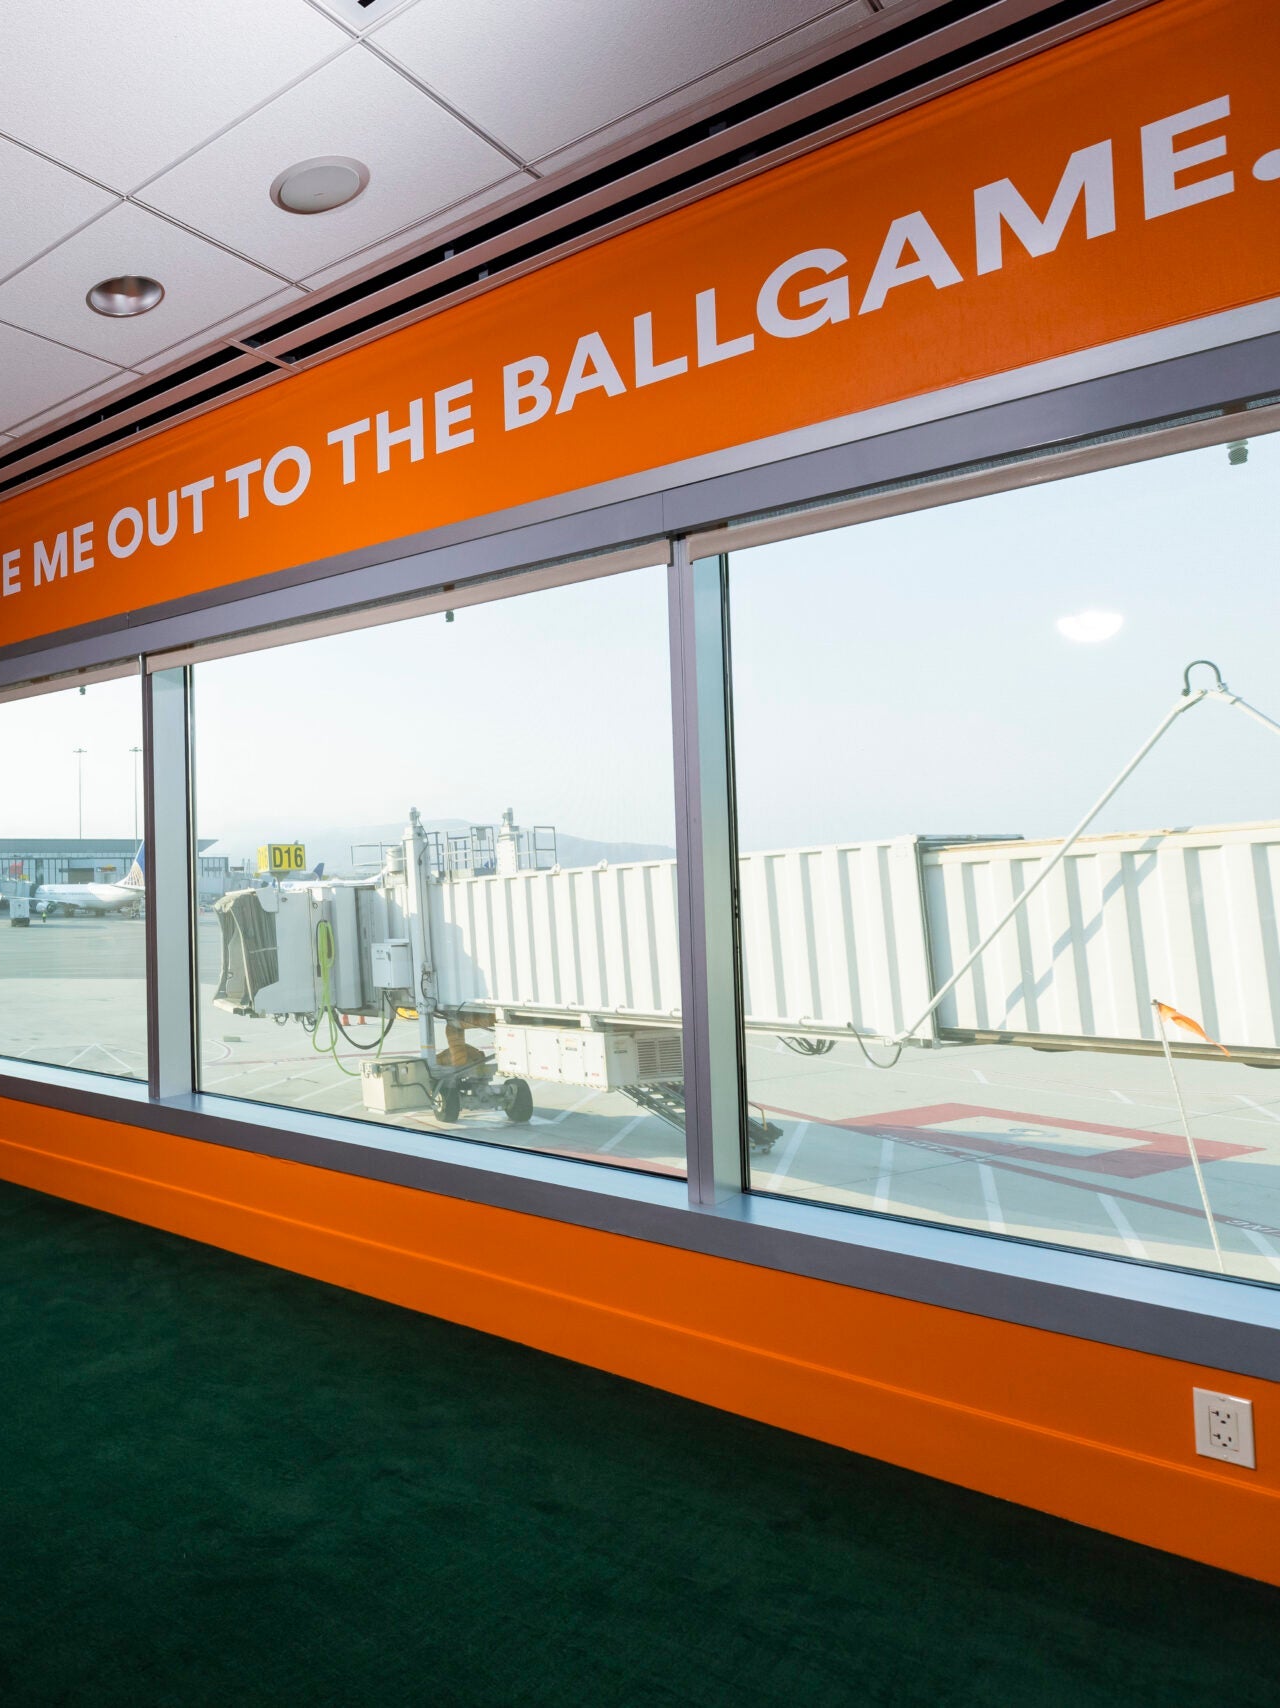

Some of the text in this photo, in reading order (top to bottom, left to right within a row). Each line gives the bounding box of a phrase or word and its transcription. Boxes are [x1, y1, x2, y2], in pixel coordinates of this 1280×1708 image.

[33, 521, 95, 586] ME
[107, 476, 215, 559] OUT
[225, 446, 312, 520] TO
[327, 379, 475, 486] THE
[272, 846, 304, 868] D16
